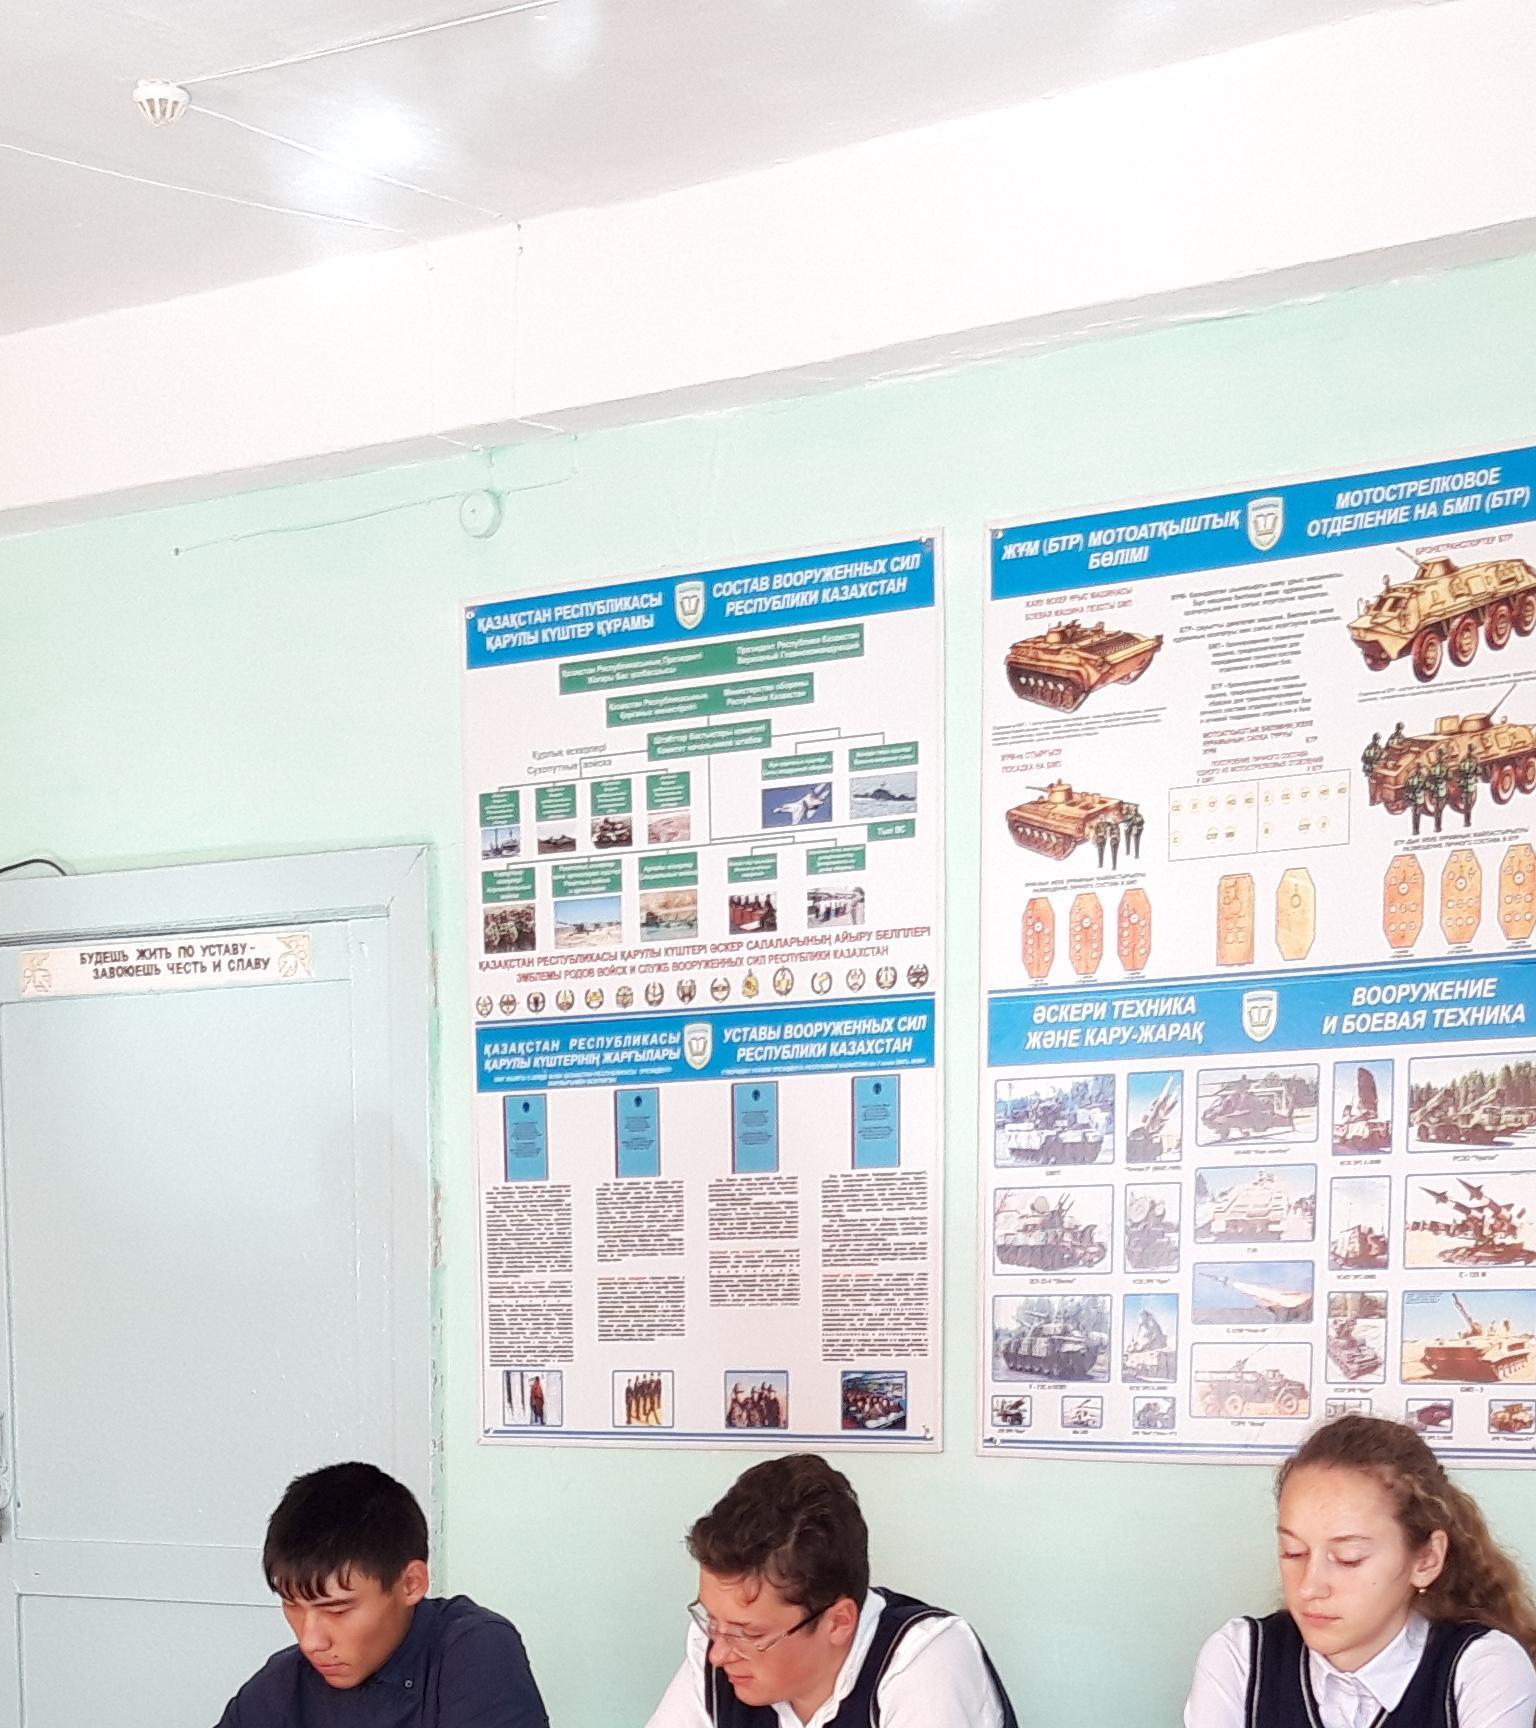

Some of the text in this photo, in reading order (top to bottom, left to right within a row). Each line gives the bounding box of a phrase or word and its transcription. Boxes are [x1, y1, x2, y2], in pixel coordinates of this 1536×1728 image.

[1336, 467, 1502, 510] МОТОСТРЕЛКОВОЕ
[1307, 487, 1531, 538] ОТДЕЛЕНИЕ НА БМП (БТР)
[1043, 533, 1084, 556] (БТР)
[1088, 510, 1241, 547] МОТОАТҚЫШТЫҚ
[713, 553, 921, 597] СОСТАВ ВООРУЖЕННЫХ СИЛ
[725, 577, 907, 617] РЕСПУБЛИКИ КАЗАХСТАН
[477, 592, 662, 634] ҚАЗАҚСТАН РЕСПУБЛИКАСЫ
[80, 951, 128, 965] БУДЕШЬ
[178, 945, 194, 958] ПО
[167, 962, 207, 974] ЧЕСТЬ
[228, 958, 270, 971] СЛАВУ
[1352, 977, 1498, 1006] ВООРУЖЕНИЕ
[1033, 996, 1196, 1024] ӘСКЕРИ ТЕХНИКА
[1322, 1003, 1525, 1034] И БОЕВАЯ ТЕХНИКА
[484, 1032, 680, 1055] ҚАЗАҚСТАН РЕСПУБЛИКАСЫ
[723, 1015, 927, 1043] УСТАВЫ ВООРУЖЕННЫХ СИЛ
[1025, 1029, 1081, 1050] ЖӘНЕ
[737, 1037, 913, 1062] РЕСПУБЛИКИ КАЗАХСТАН
